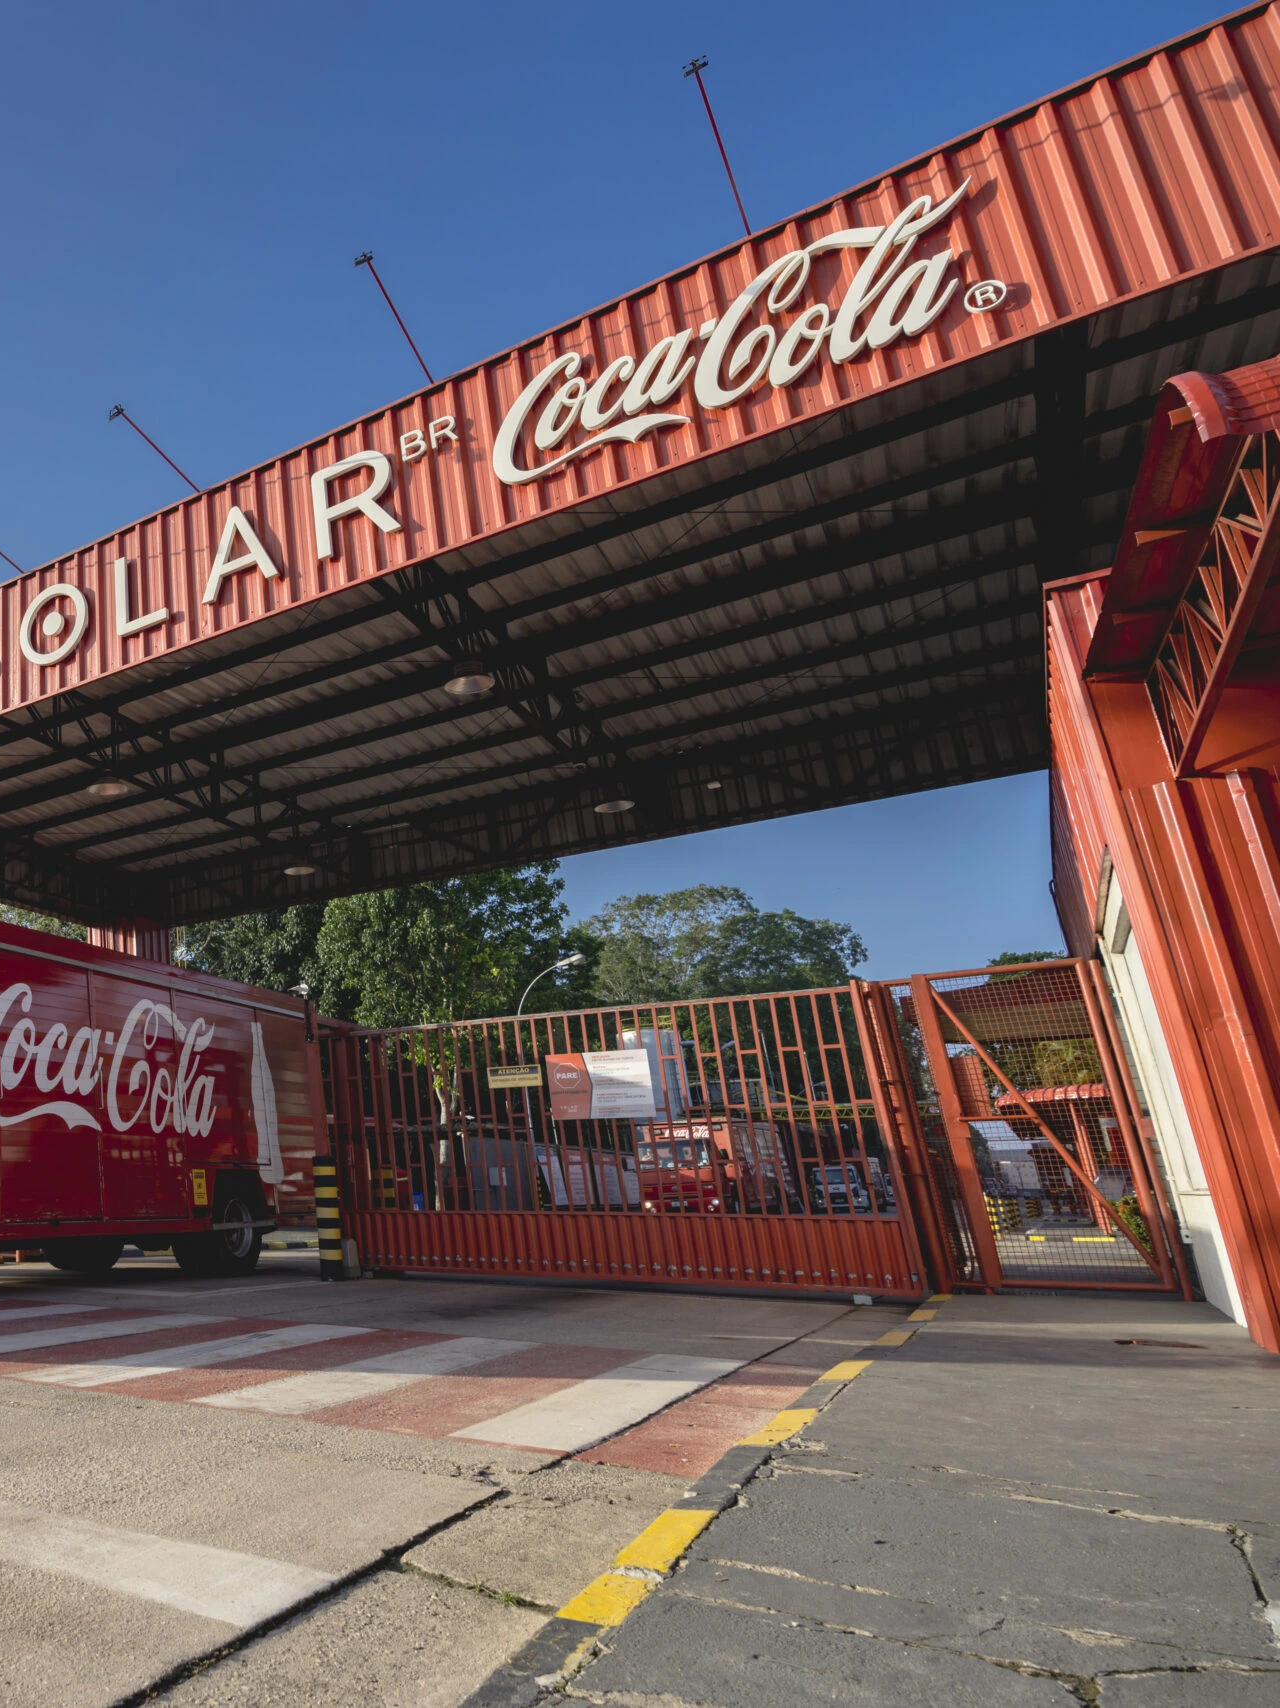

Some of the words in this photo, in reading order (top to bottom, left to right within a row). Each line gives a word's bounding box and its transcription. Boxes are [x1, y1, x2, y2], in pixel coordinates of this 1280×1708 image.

[401, 415, 459, 462] BR
[492, 174, 972, 486] Coca-Cola
[556, 1072, 578, 1080] PARE
